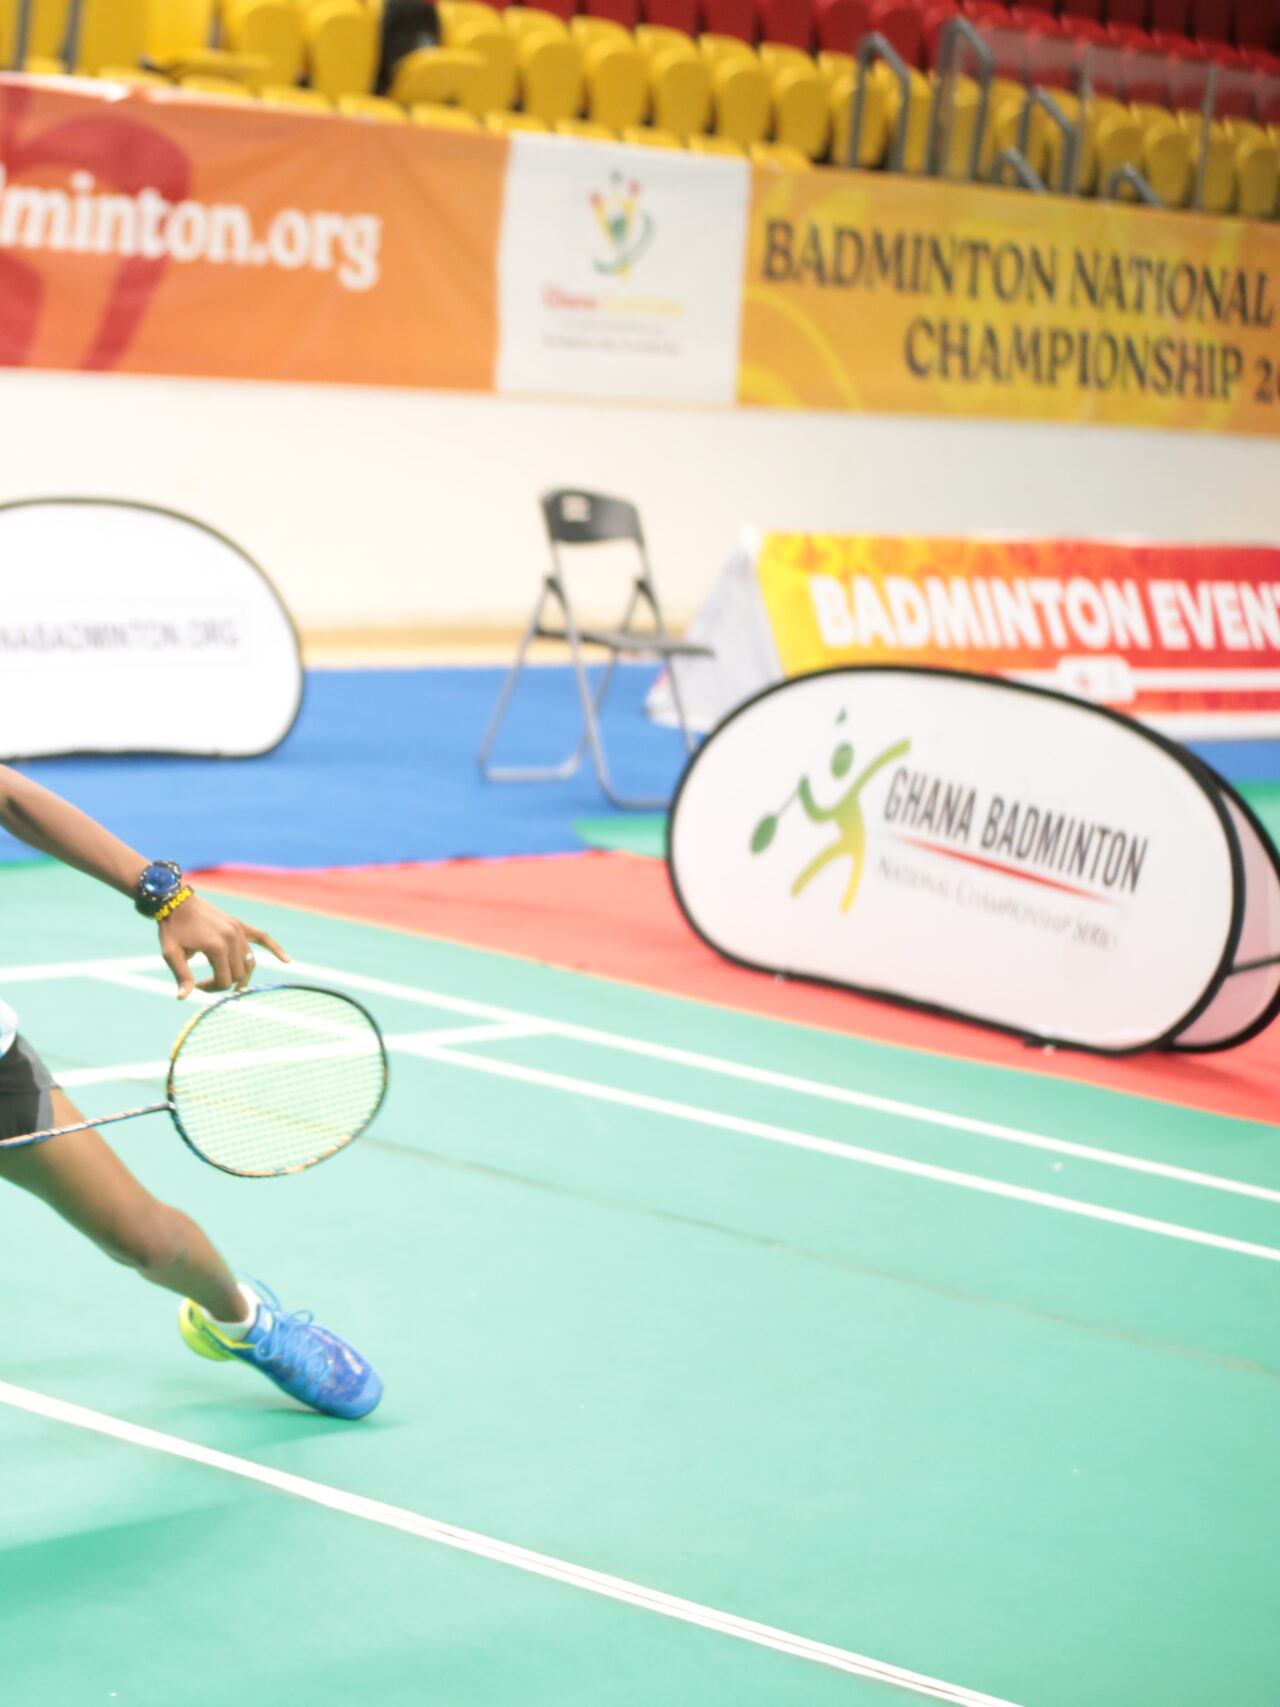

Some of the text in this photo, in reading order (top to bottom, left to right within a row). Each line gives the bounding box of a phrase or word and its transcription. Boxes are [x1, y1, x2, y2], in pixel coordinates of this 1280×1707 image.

[761, 218, 1059, 303] BADMINTON
[1070, 247, 1275, 328] NATIONAL
[903, 314, 1280, 404] CHAMPIONSHIP 2
[809, 573, 1152, 651] BADMINTON
[882, 765, 1149, 894] GHANA BADMINTON
